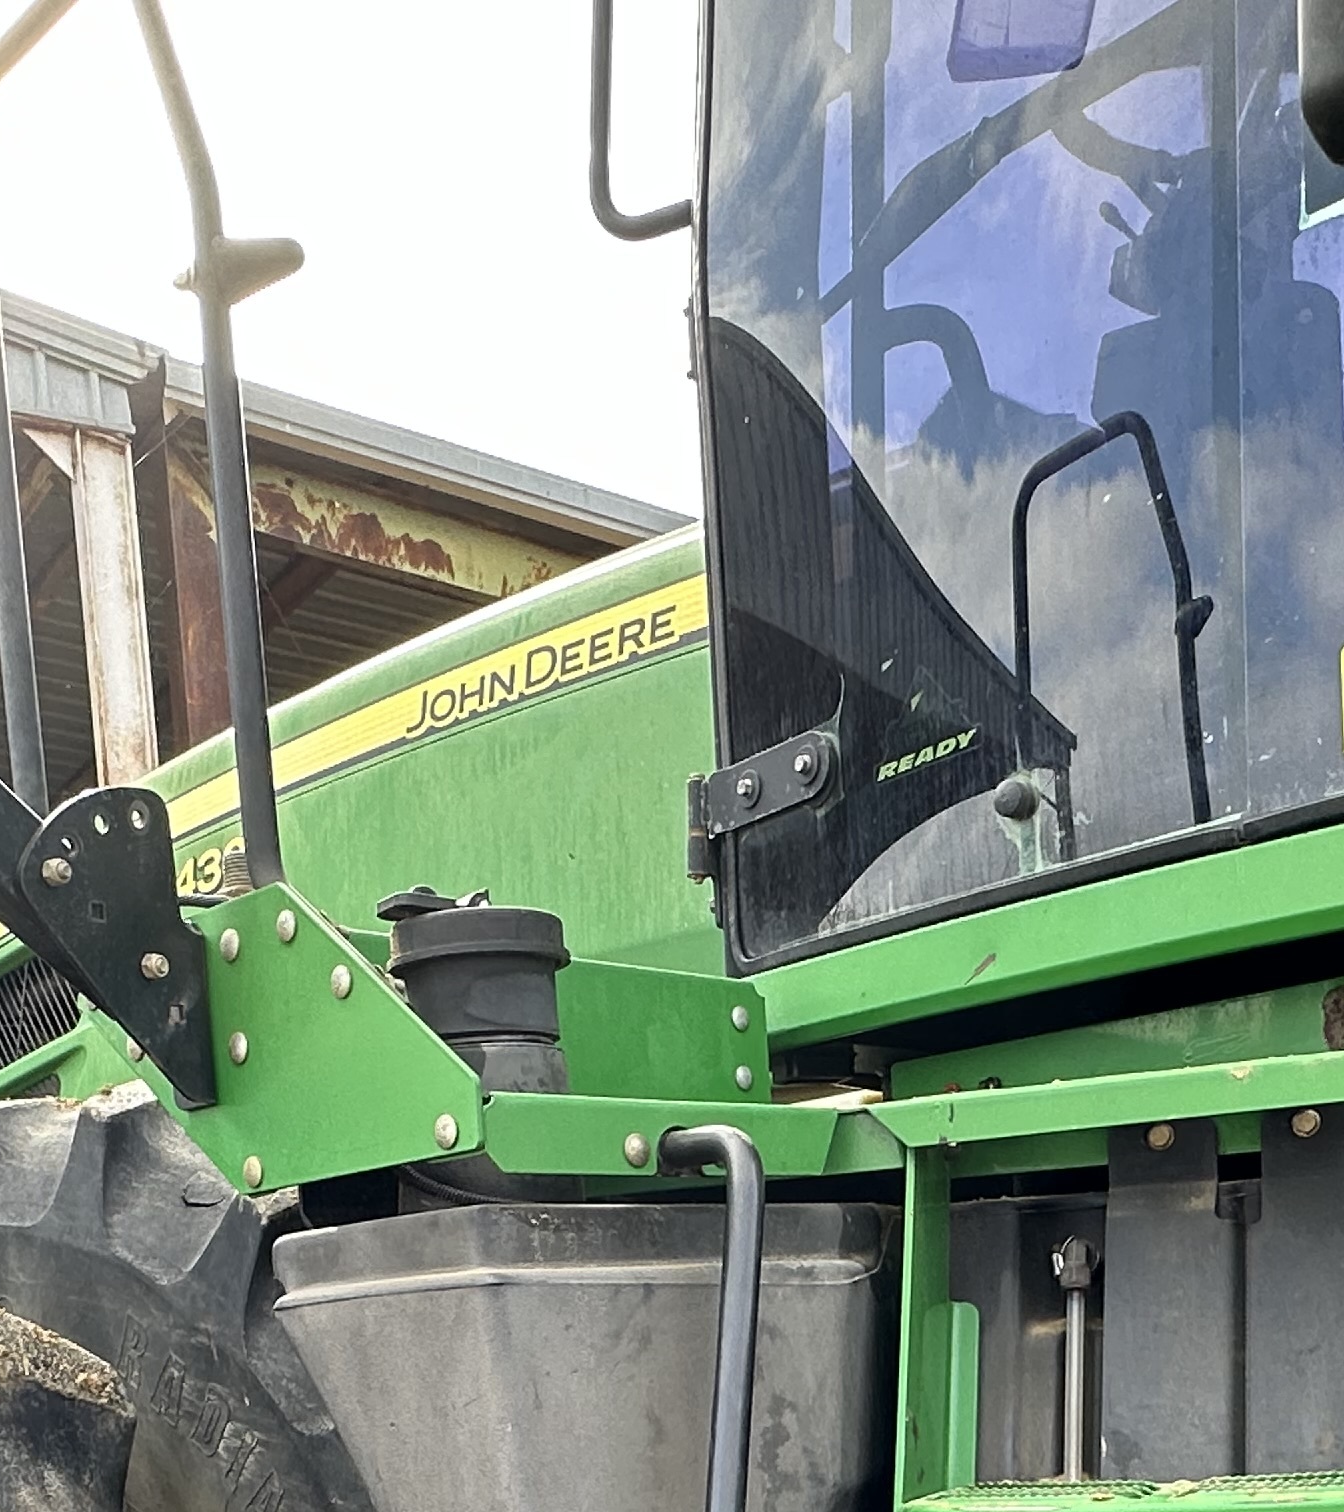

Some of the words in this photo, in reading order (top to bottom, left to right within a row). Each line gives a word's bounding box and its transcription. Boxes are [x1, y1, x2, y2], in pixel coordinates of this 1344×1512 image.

[406, 663, 516, 736] JOHN
[524, 604, 678, 689] DEERE
[876, 728, 977, 783] READY
